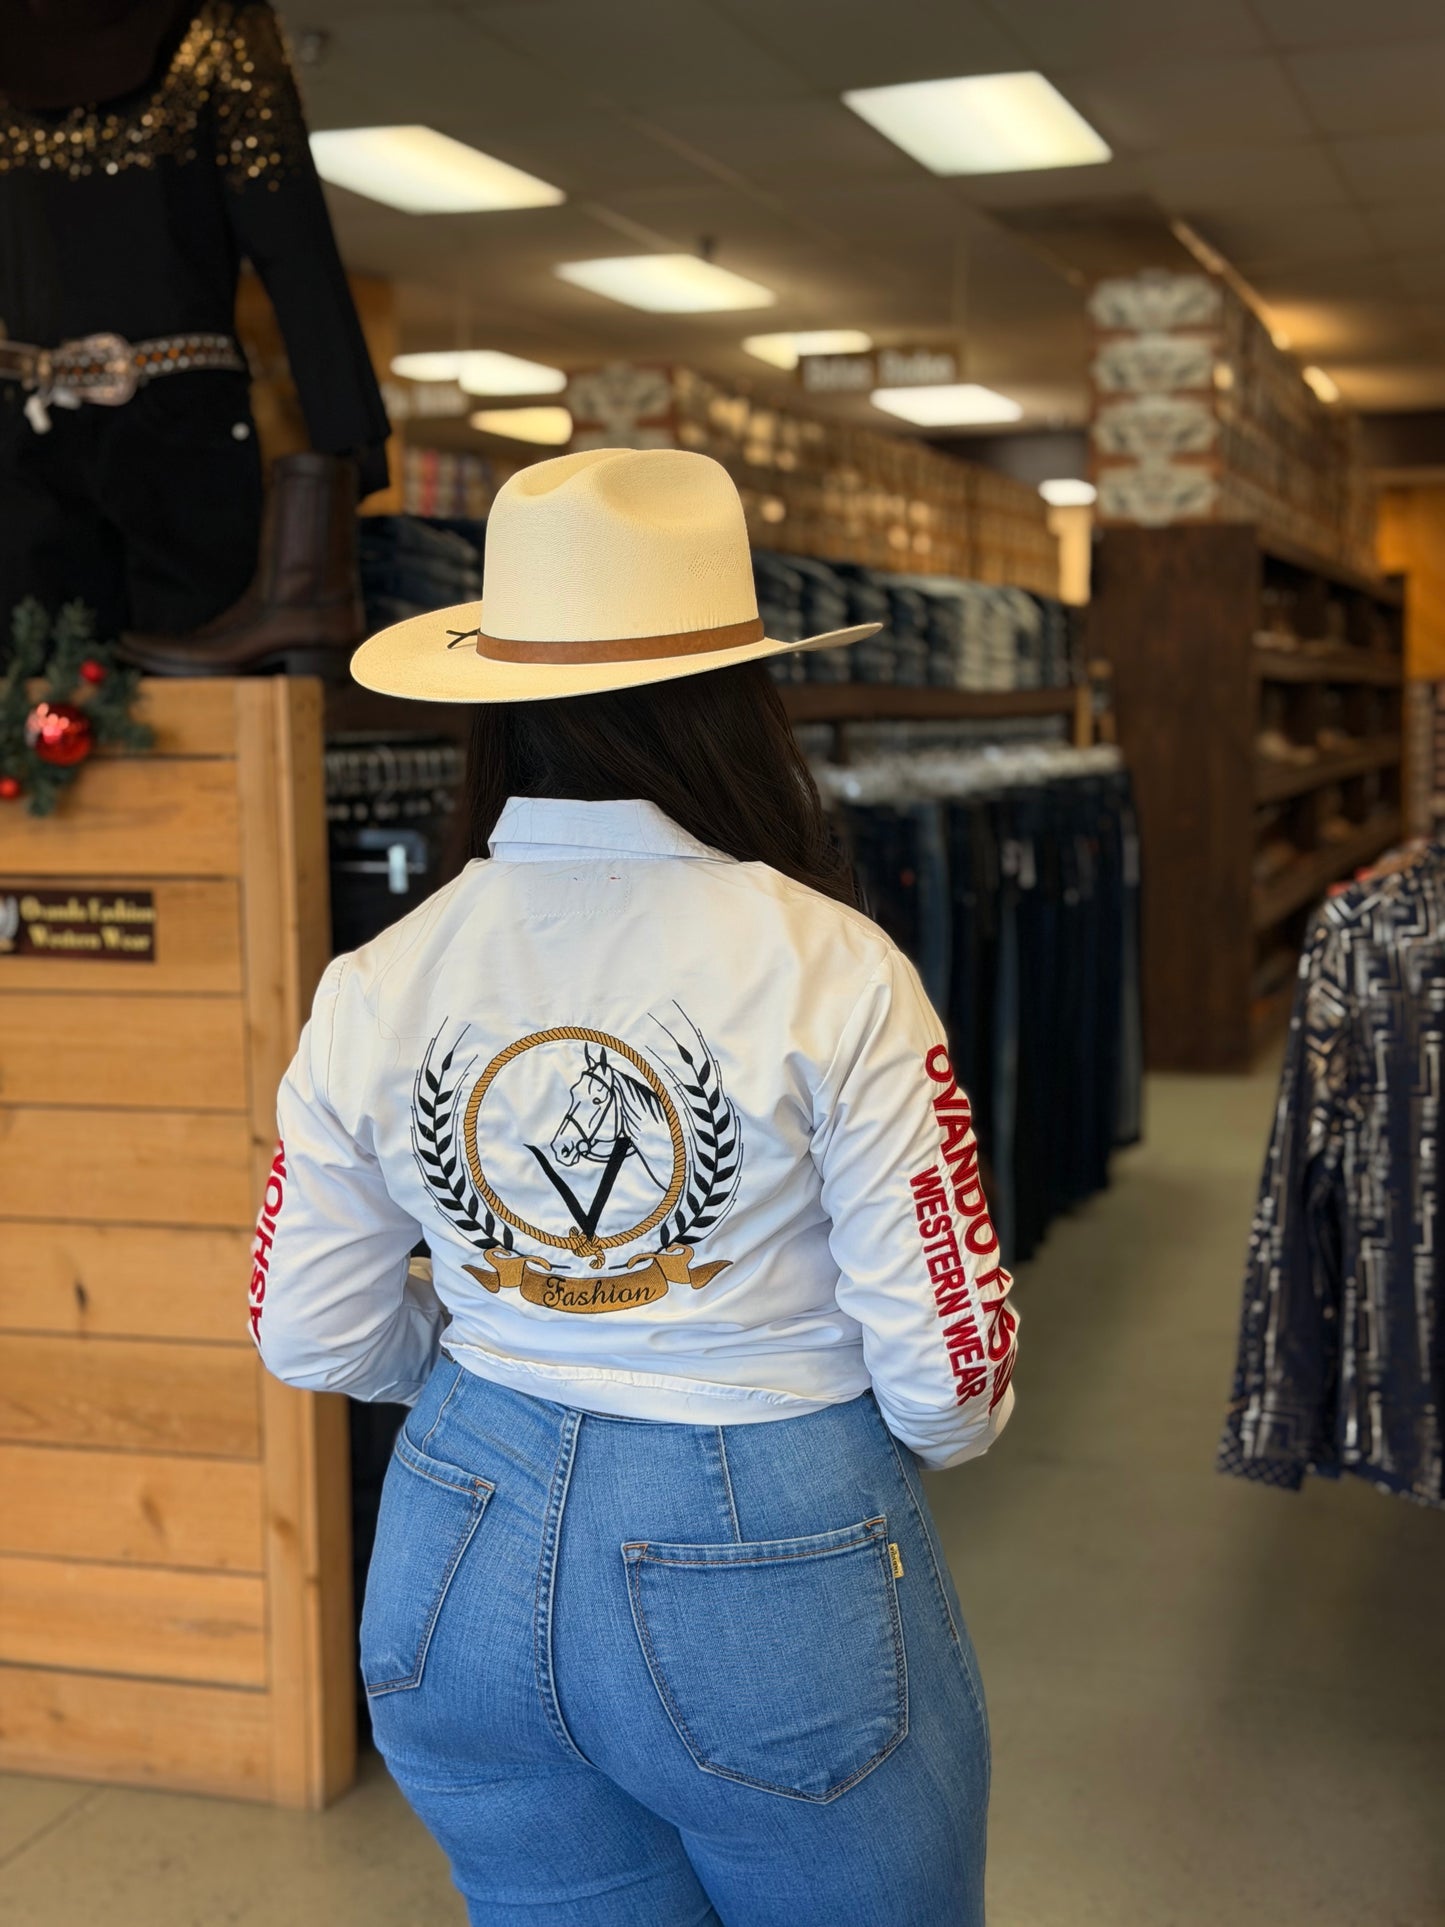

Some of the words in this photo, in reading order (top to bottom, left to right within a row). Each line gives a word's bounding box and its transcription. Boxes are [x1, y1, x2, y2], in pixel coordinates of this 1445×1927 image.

[925, 1044, 1000, 1256] OVANDO
[543, 1276, 656, 1308] Fashion
[909, 1165, 972, 1318] WESTERN
[943, 1315, 988, 1406] WEAR
